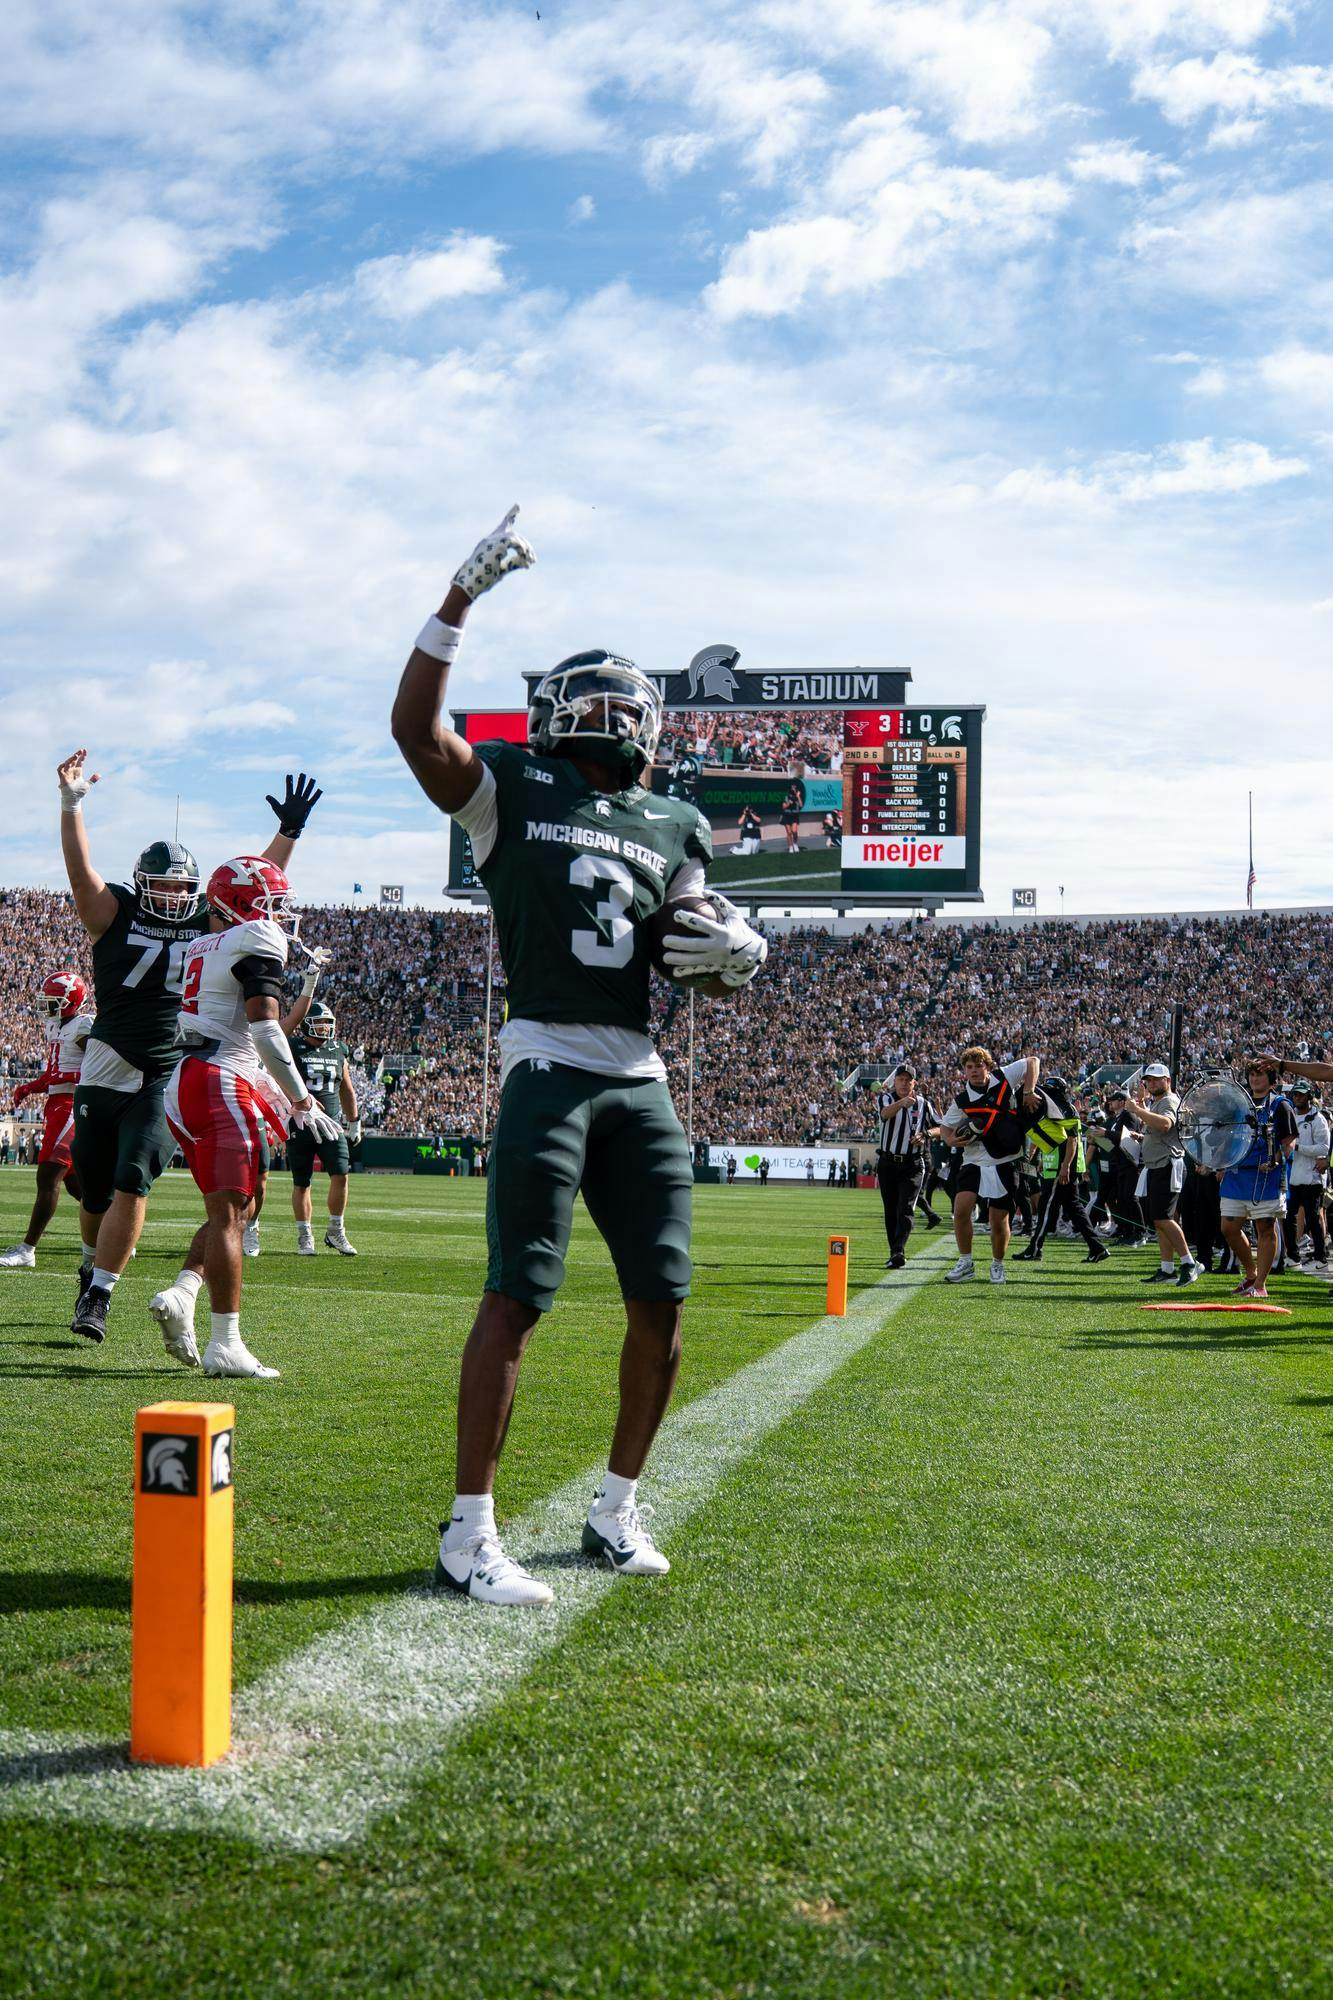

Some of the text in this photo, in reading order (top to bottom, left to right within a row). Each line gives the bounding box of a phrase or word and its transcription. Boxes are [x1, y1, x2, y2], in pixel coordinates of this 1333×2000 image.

[761, 674, 879, 701] STADIUM
[878, 714, 891, 732] 3
[919, 714, 932, 732] 0
[845, 751, 861, 759] 2ND
[872, 751, 878, 759] 6
[892, 748, 922, 762] 1:13
[955, 750, 961, 758] 8
[862, 772, 870, 781] 11
[938, 772, 948, 781] 14
[862, 785, 870, 794] 0
[939, 785, 946, 794] 0
[862, 797, 869, 807] 0
[939, 797, 946, 807] 0
[862, 810, 869, 819] 0
[939, 810, 946, 819] 0
[861, 824, 869, 833] 0
[939, 823, 946, 832] 0
[525, 821, 668, 877] MICHIGAN STATE
[863, 836, 944, 868] meijer
[383, 888, 401, 901] 40
[1015, 891, 1033, 905] 40
[569, 854, 635, 969] 3
[130, 920, 202, 940] MICHIGAN STATE
[305, 1064, 337, 1094] 51
